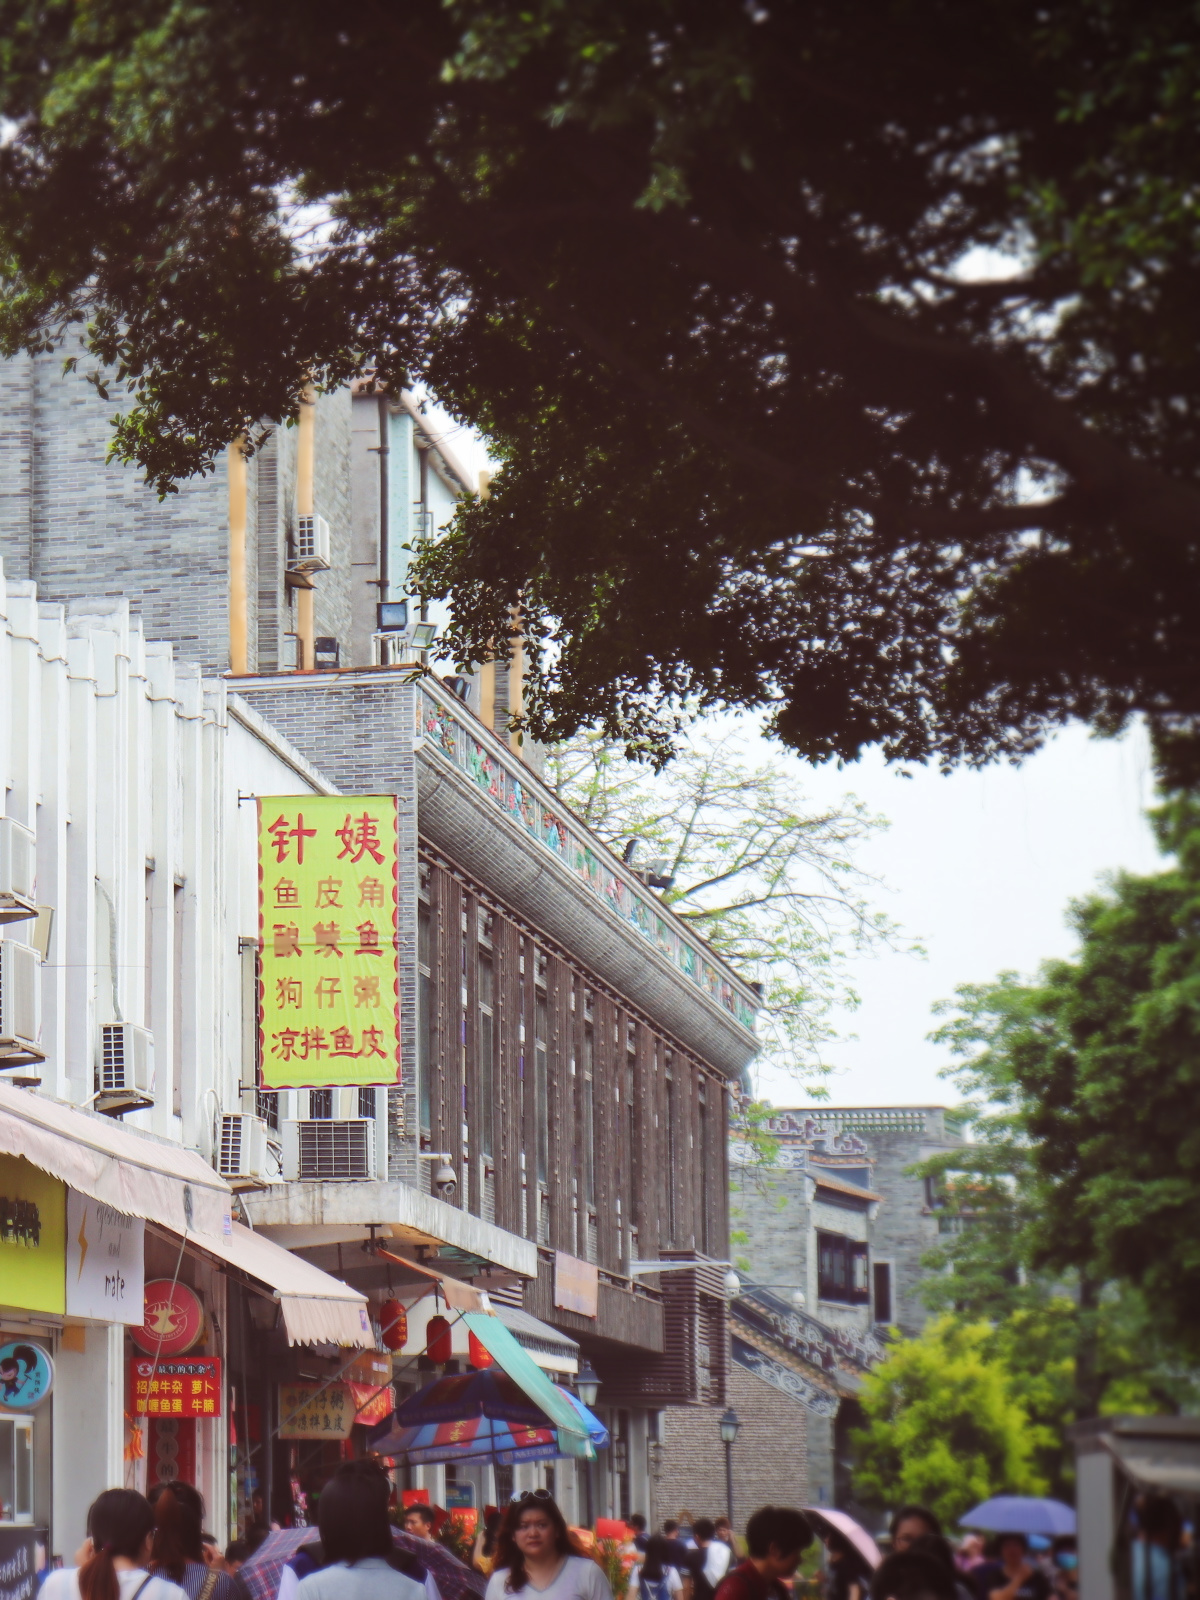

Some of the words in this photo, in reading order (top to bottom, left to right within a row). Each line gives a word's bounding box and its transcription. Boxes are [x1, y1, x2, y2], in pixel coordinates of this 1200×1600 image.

[267, 811, 386, 865] 针姨
[273, 875, 385, 909] 鱼皮角
[275, 975, 381, 1010] 狗仔粥
[271, 1025, 388, 1062] 凉拌鱼皮
[104, 1269, 125, 1301] mate
[158, 1364, 207, 1374] 最牛的牛杂
[136, 1380, 183, 1395] 招牌牛杂
[191, 1380, 215, 1395] 萝卜
[136, 1398, 183, 1413] 咖喱鱼蛋
[191, 1398, 215, 1413] 牛腩
